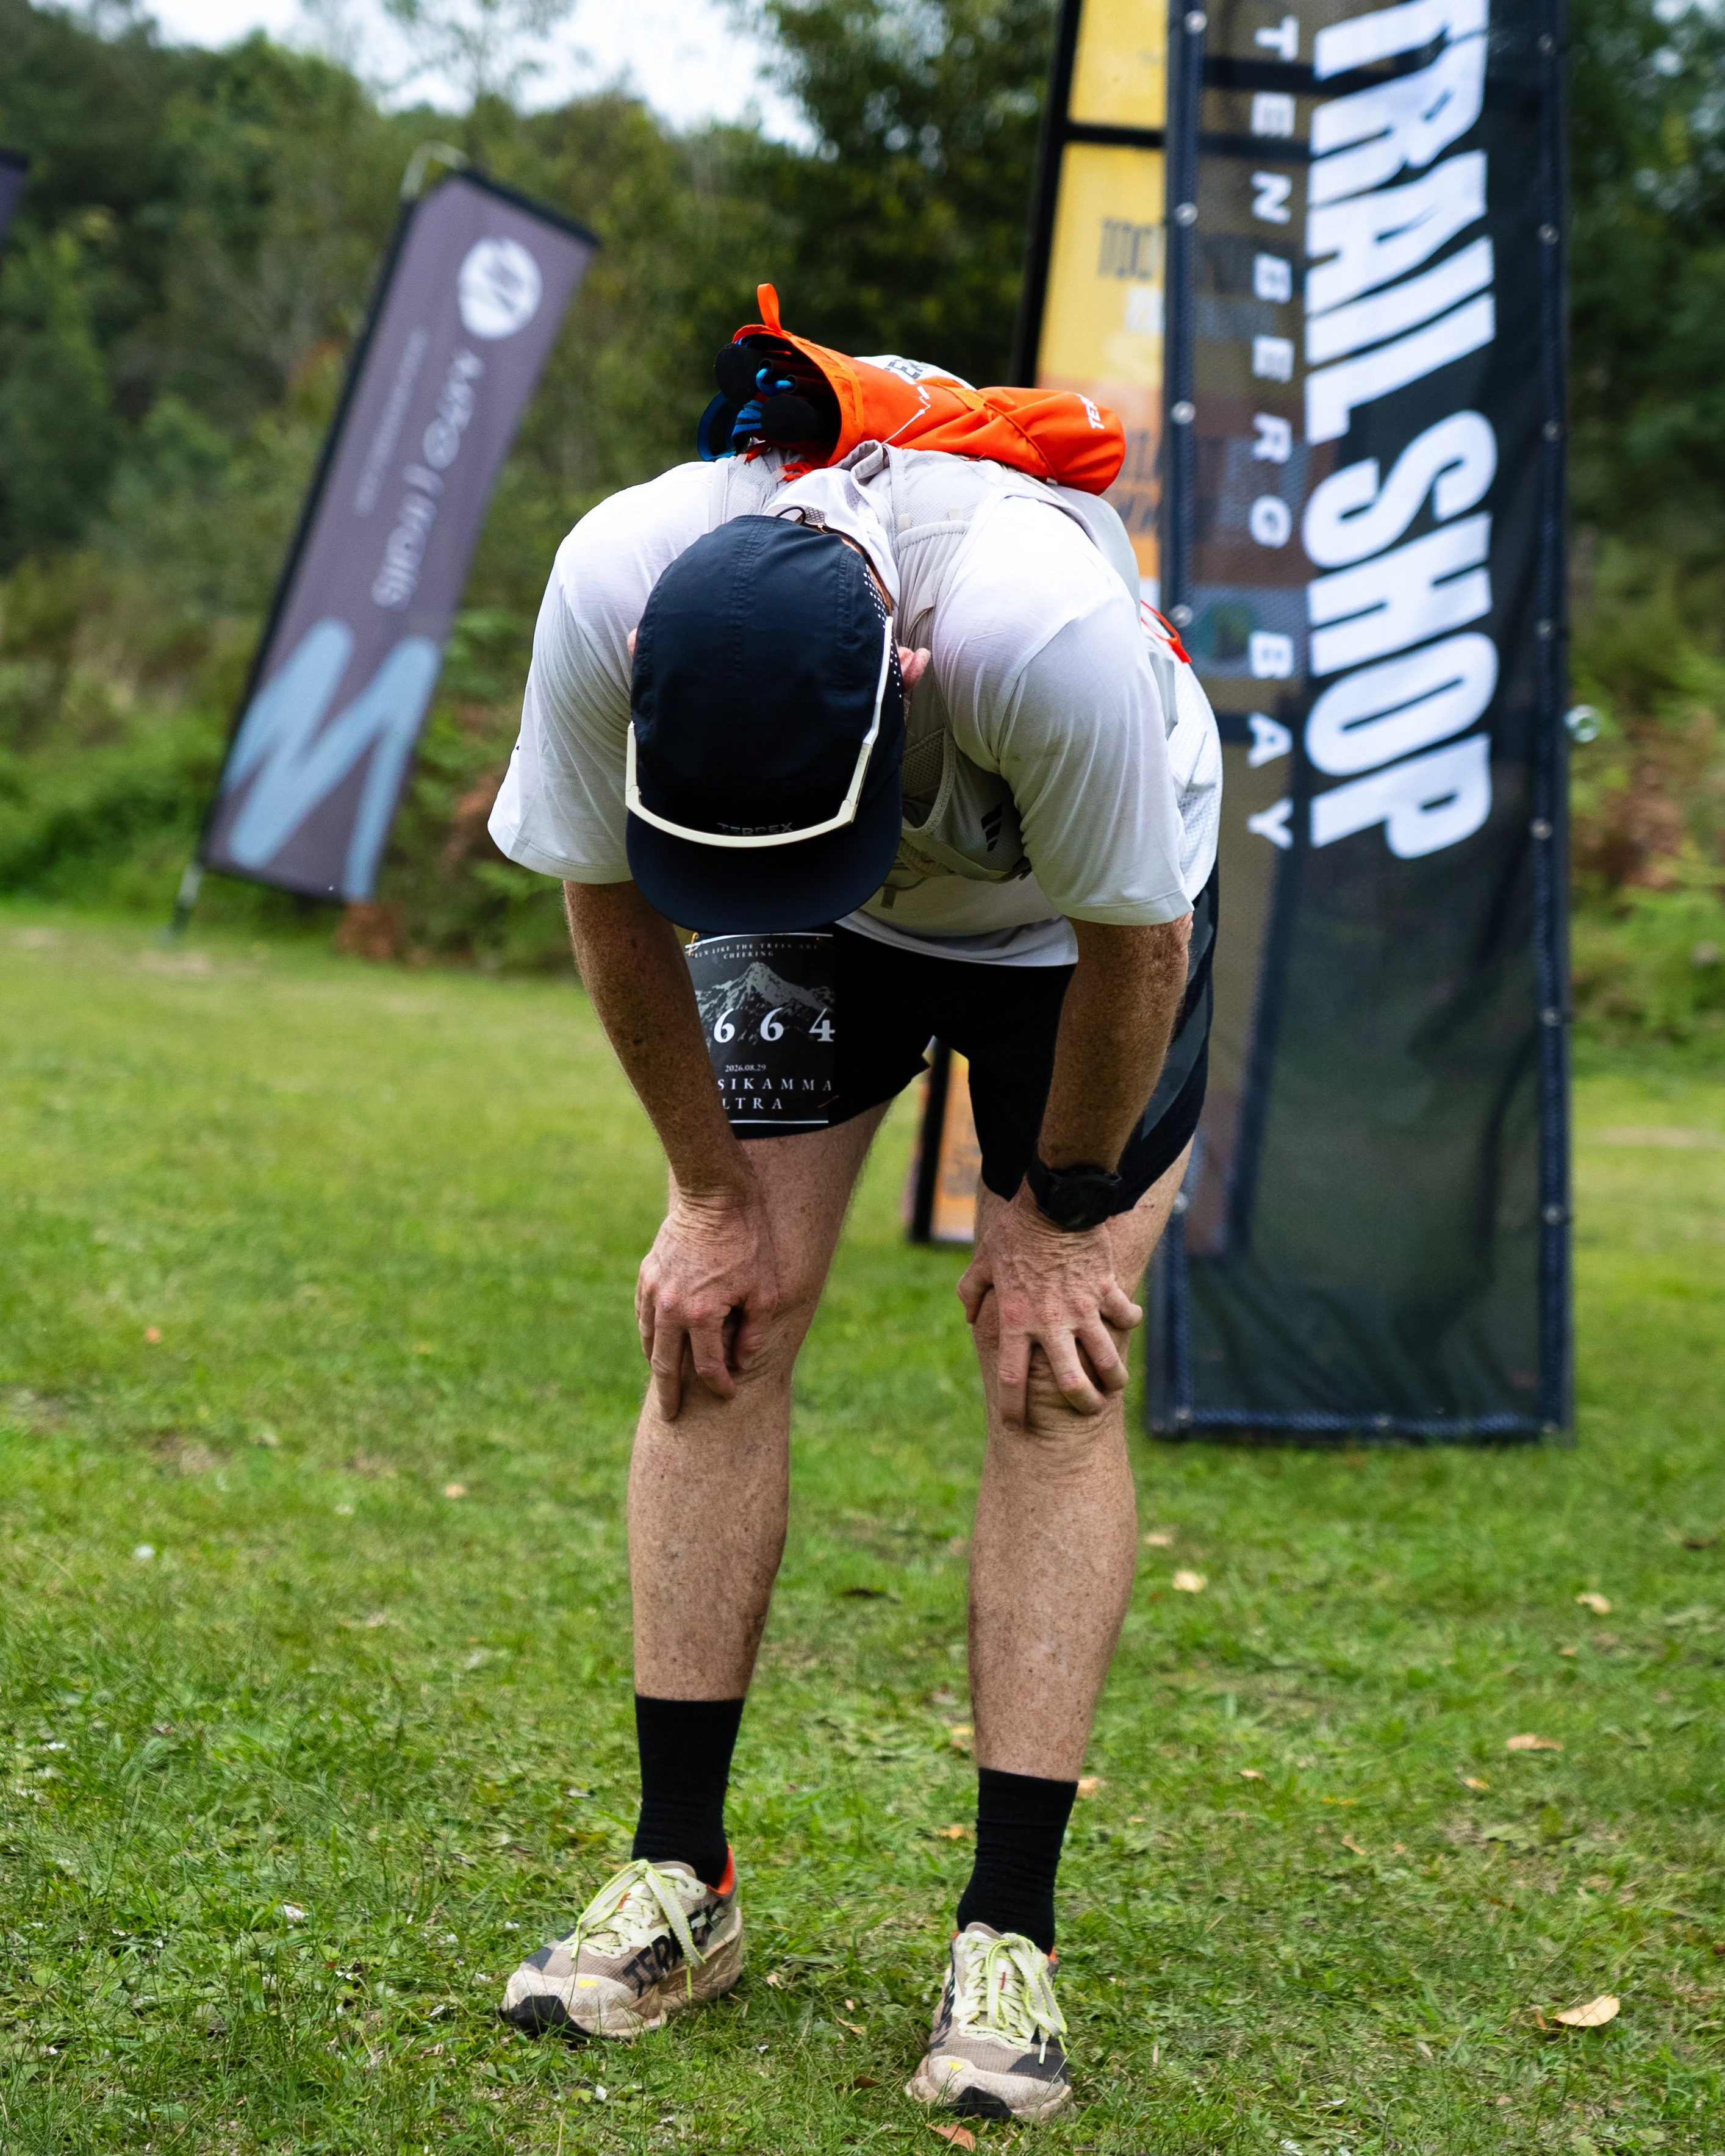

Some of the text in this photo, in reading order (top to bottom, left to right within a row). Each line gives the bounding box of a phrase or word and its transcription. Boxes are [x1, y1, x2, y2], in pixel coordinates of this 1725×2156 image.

[1303, 0, 1499, 860] TRAIL SHOP
[1247, 631, 1295, 850] BAY
[712, 945, 730, 954] LIKE
[722, 951, 774, 960] CHEERING
[713, 1007, 836, 1044] 664
